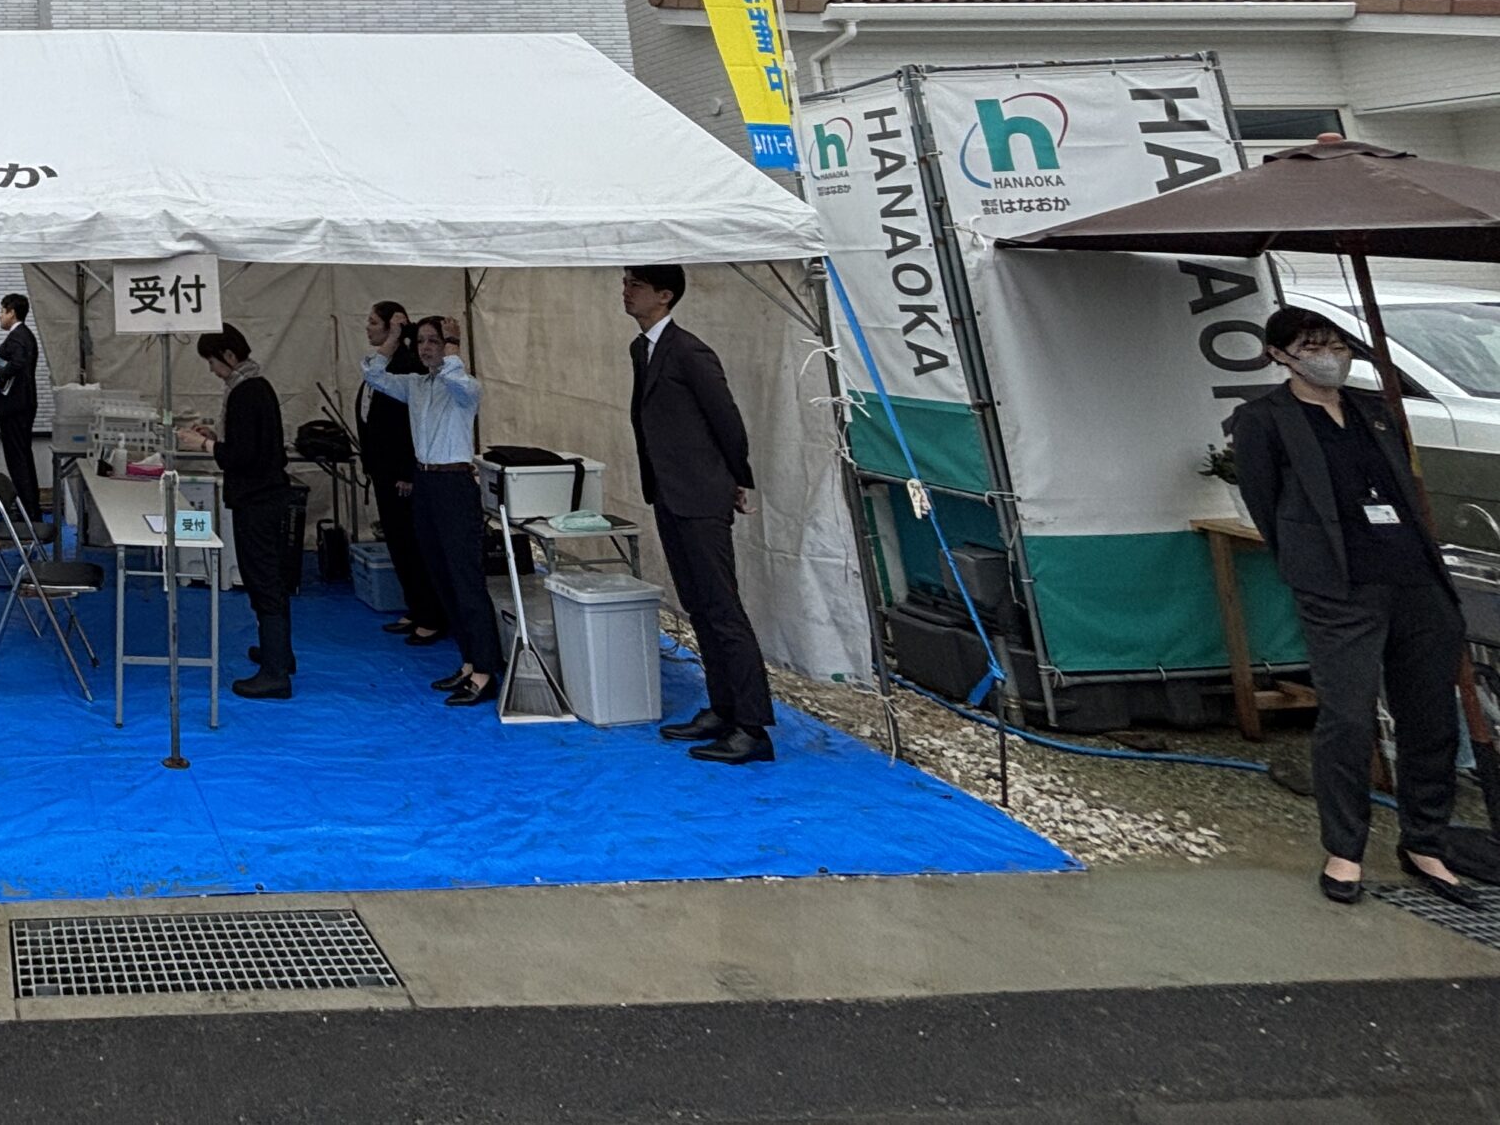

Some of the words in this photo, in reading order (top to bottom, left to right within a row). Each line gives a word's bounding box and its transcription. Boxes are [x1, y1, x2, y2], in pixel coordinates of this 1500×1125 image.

[994, 175, 1065, 190] HANAOKA
[999, 196, 1071, 214] はなおか
[863, 107, 950, 377] HANAOKA
[129, 274, 206, 314] 受付
[181, 518, 206, 532] 受付
